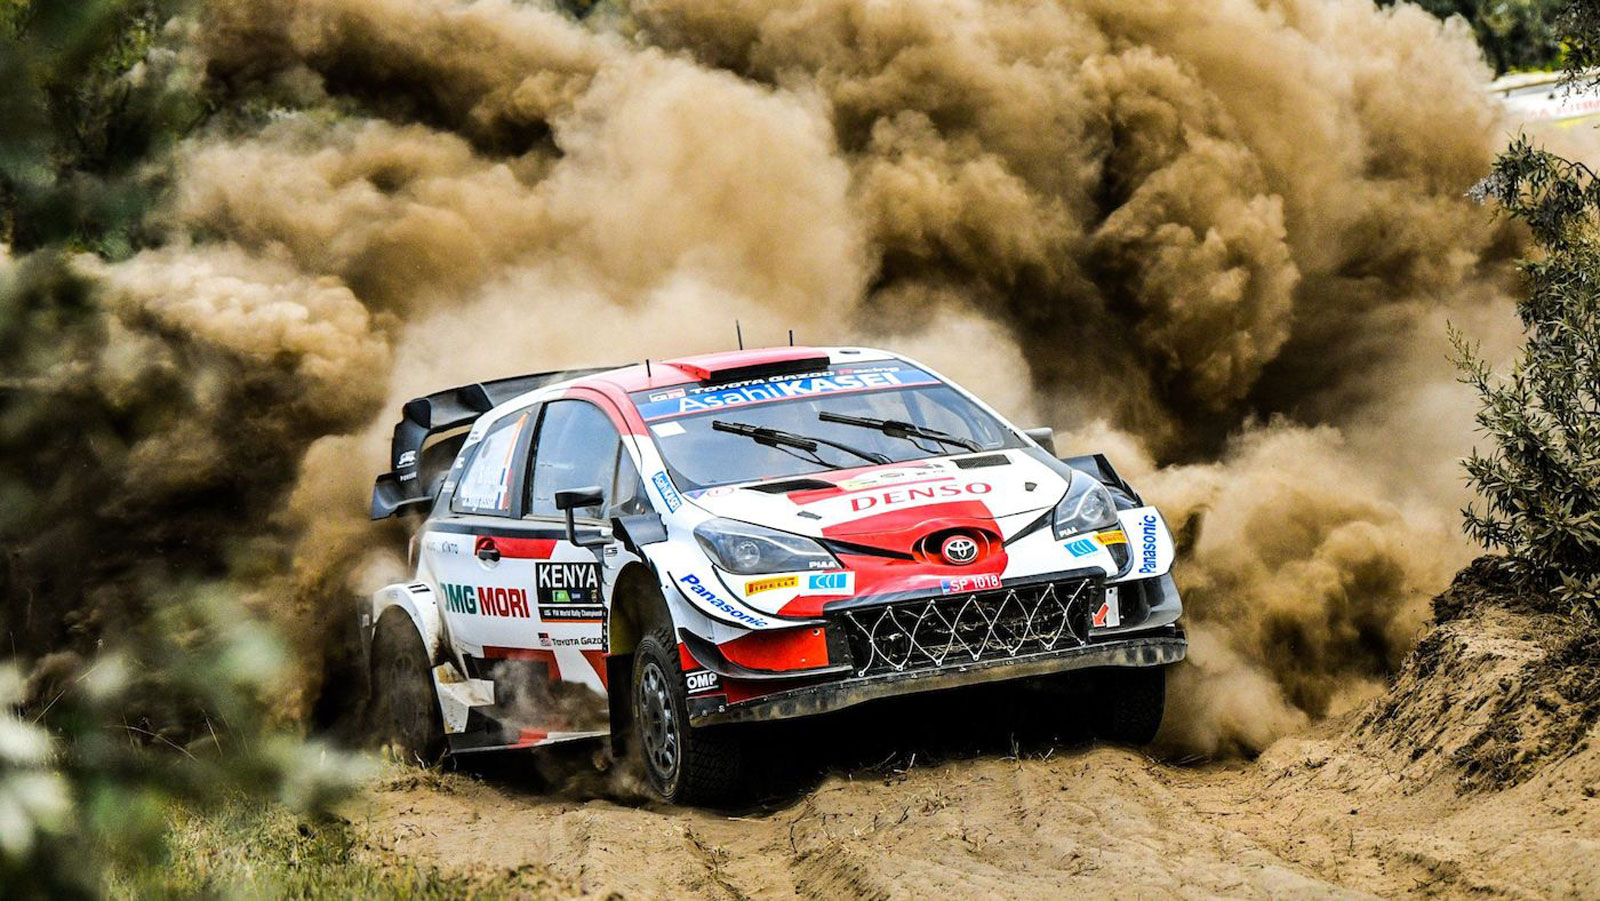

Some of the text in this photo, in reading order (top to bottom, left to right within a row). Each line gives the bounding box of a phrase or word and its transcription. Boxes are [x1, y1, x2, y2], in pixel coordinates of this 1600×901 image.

[690, 378, 765, 394] TOYOTA
[769, 370, 835, 384] GAZOO
[838, 366, 900, 376] Racing
[850, 482, 993, 512] DENSO
[1138, 514, 1157, 574] Panasonic
[538, 564, 599, 588] KENYA
[808, 560, 837, 569] PIAA
[949, 574, 999, 593] SP 1018
[477, 587, 531, 618] MORI
[680, 573, 768, 628] Panasonic
[551, 638, 580, 646] TOYOTA
[687, 673, 717, 689] OMP
